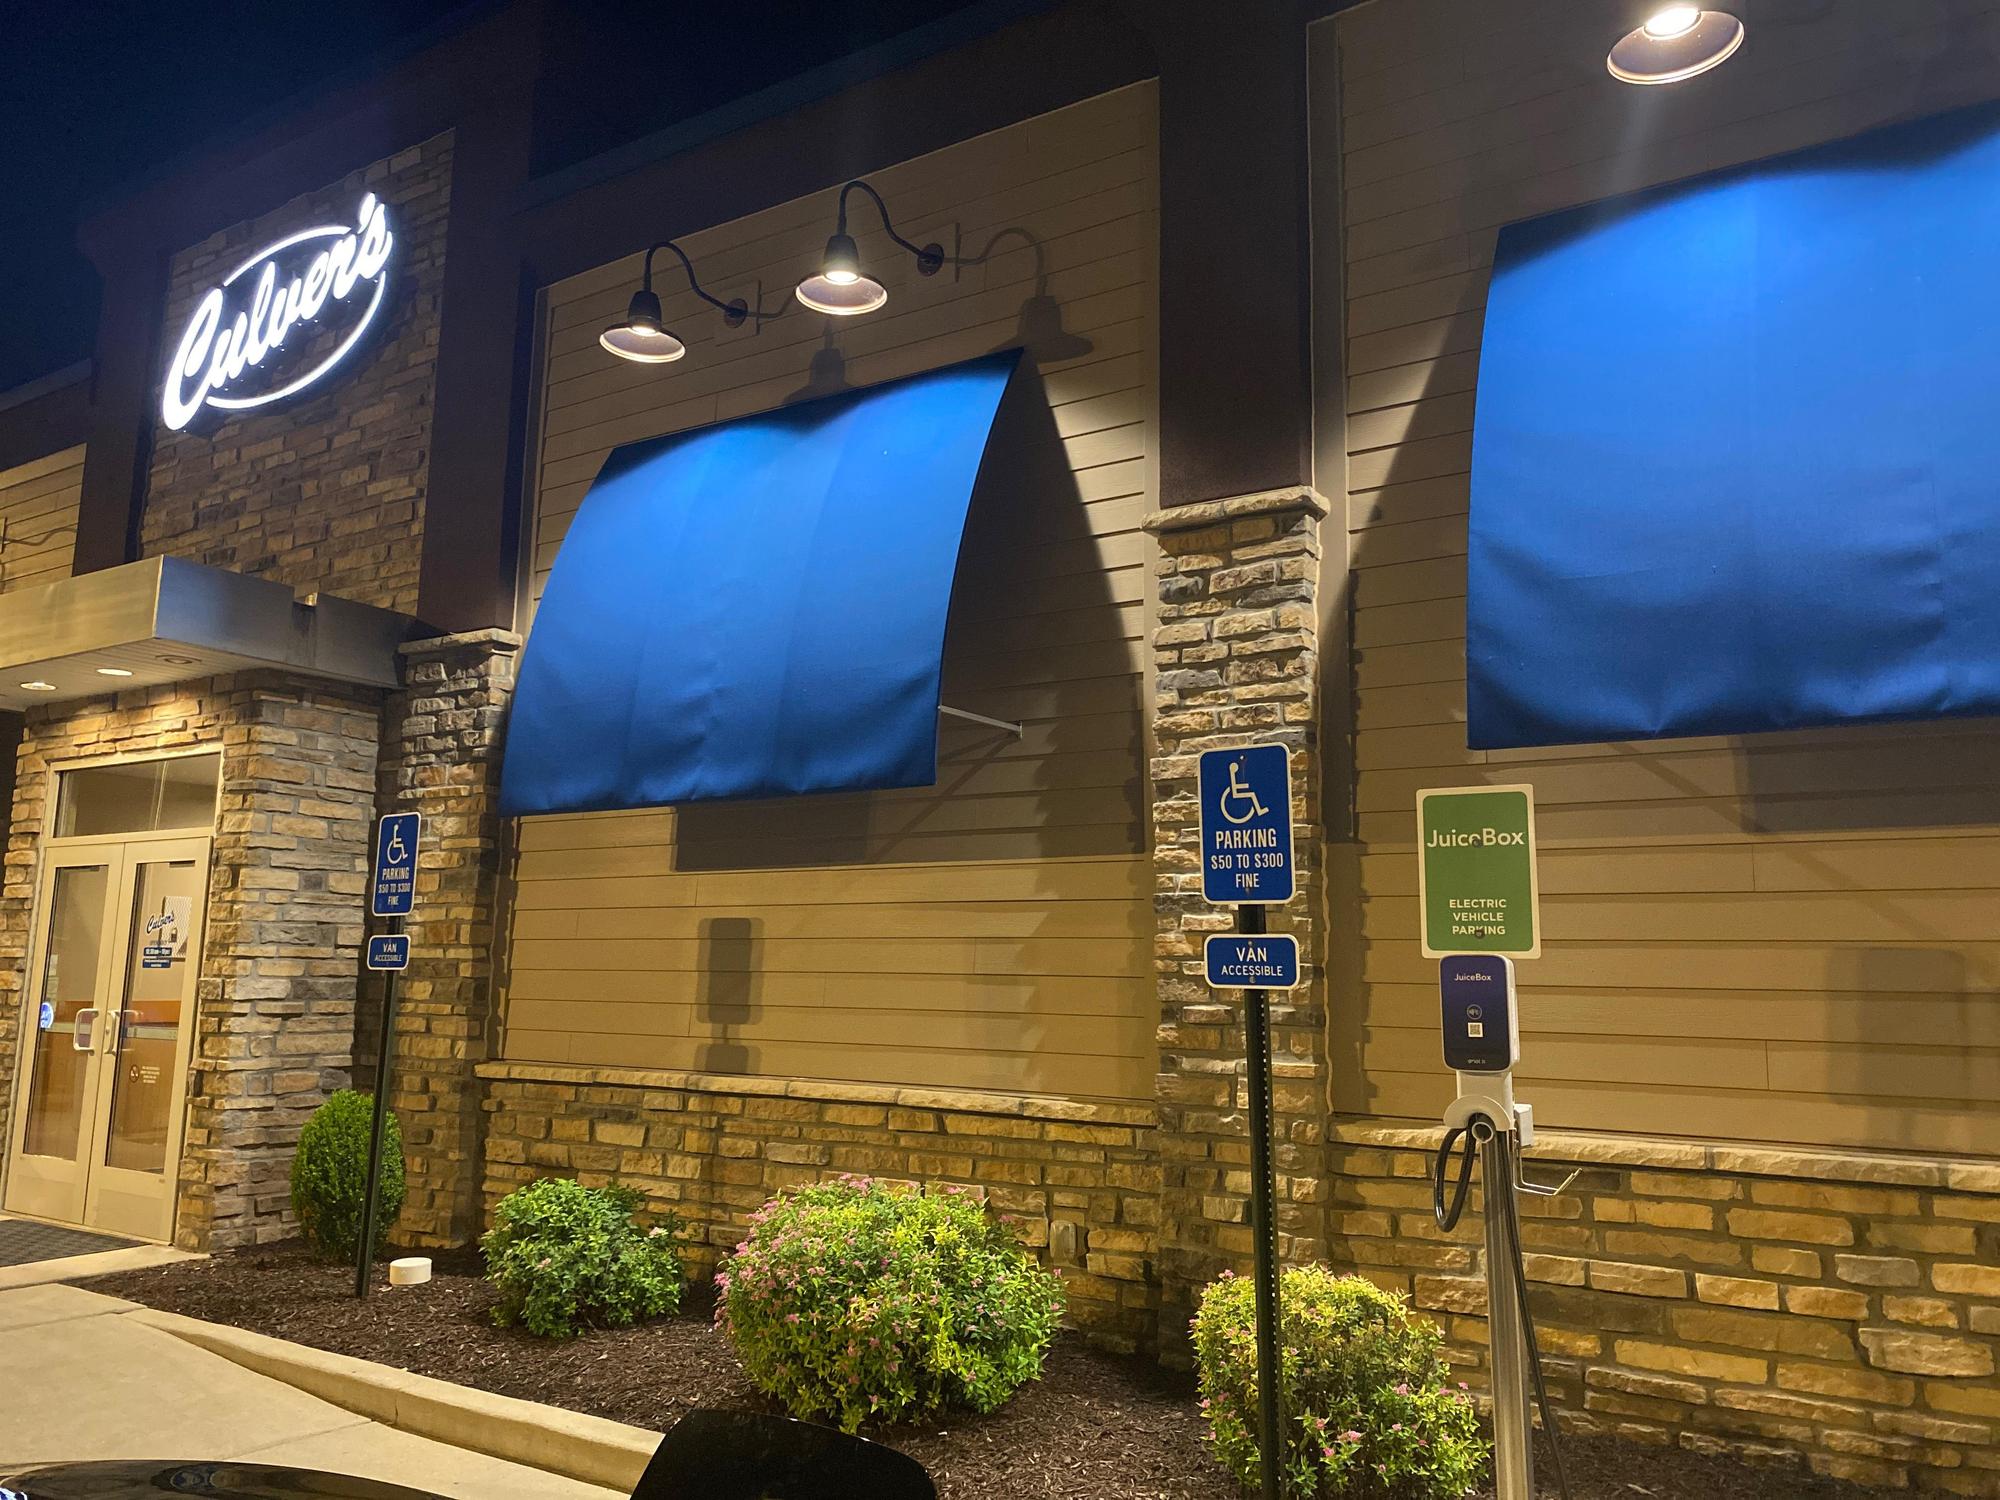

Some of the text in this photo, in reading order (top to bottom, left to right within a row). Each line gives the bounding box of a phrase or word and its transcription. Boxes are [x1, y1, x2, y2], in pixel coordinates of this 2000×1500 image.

[163, 192, 393, 431] Culver's
[1216, 828, 1277, 849] PARKING
[1427, 828, 1525, 847] JuiceBox
[1236, 854, 1250, 869] TO
[382, 867, 410, 881] PARKING
[1235, 873, 1260, 888] FINE
[1449, 899, 1507, 908] ELECTRIC
[1453, 912, 1504, 922] VEHICLE
[383, 943, 398, 953] VAN
[1236, 947, 1267, 962] VAN
[1221, 965, 1284, 976] ACCESSIBLE
[1454, 973, 1492, 981] JuiceBox
